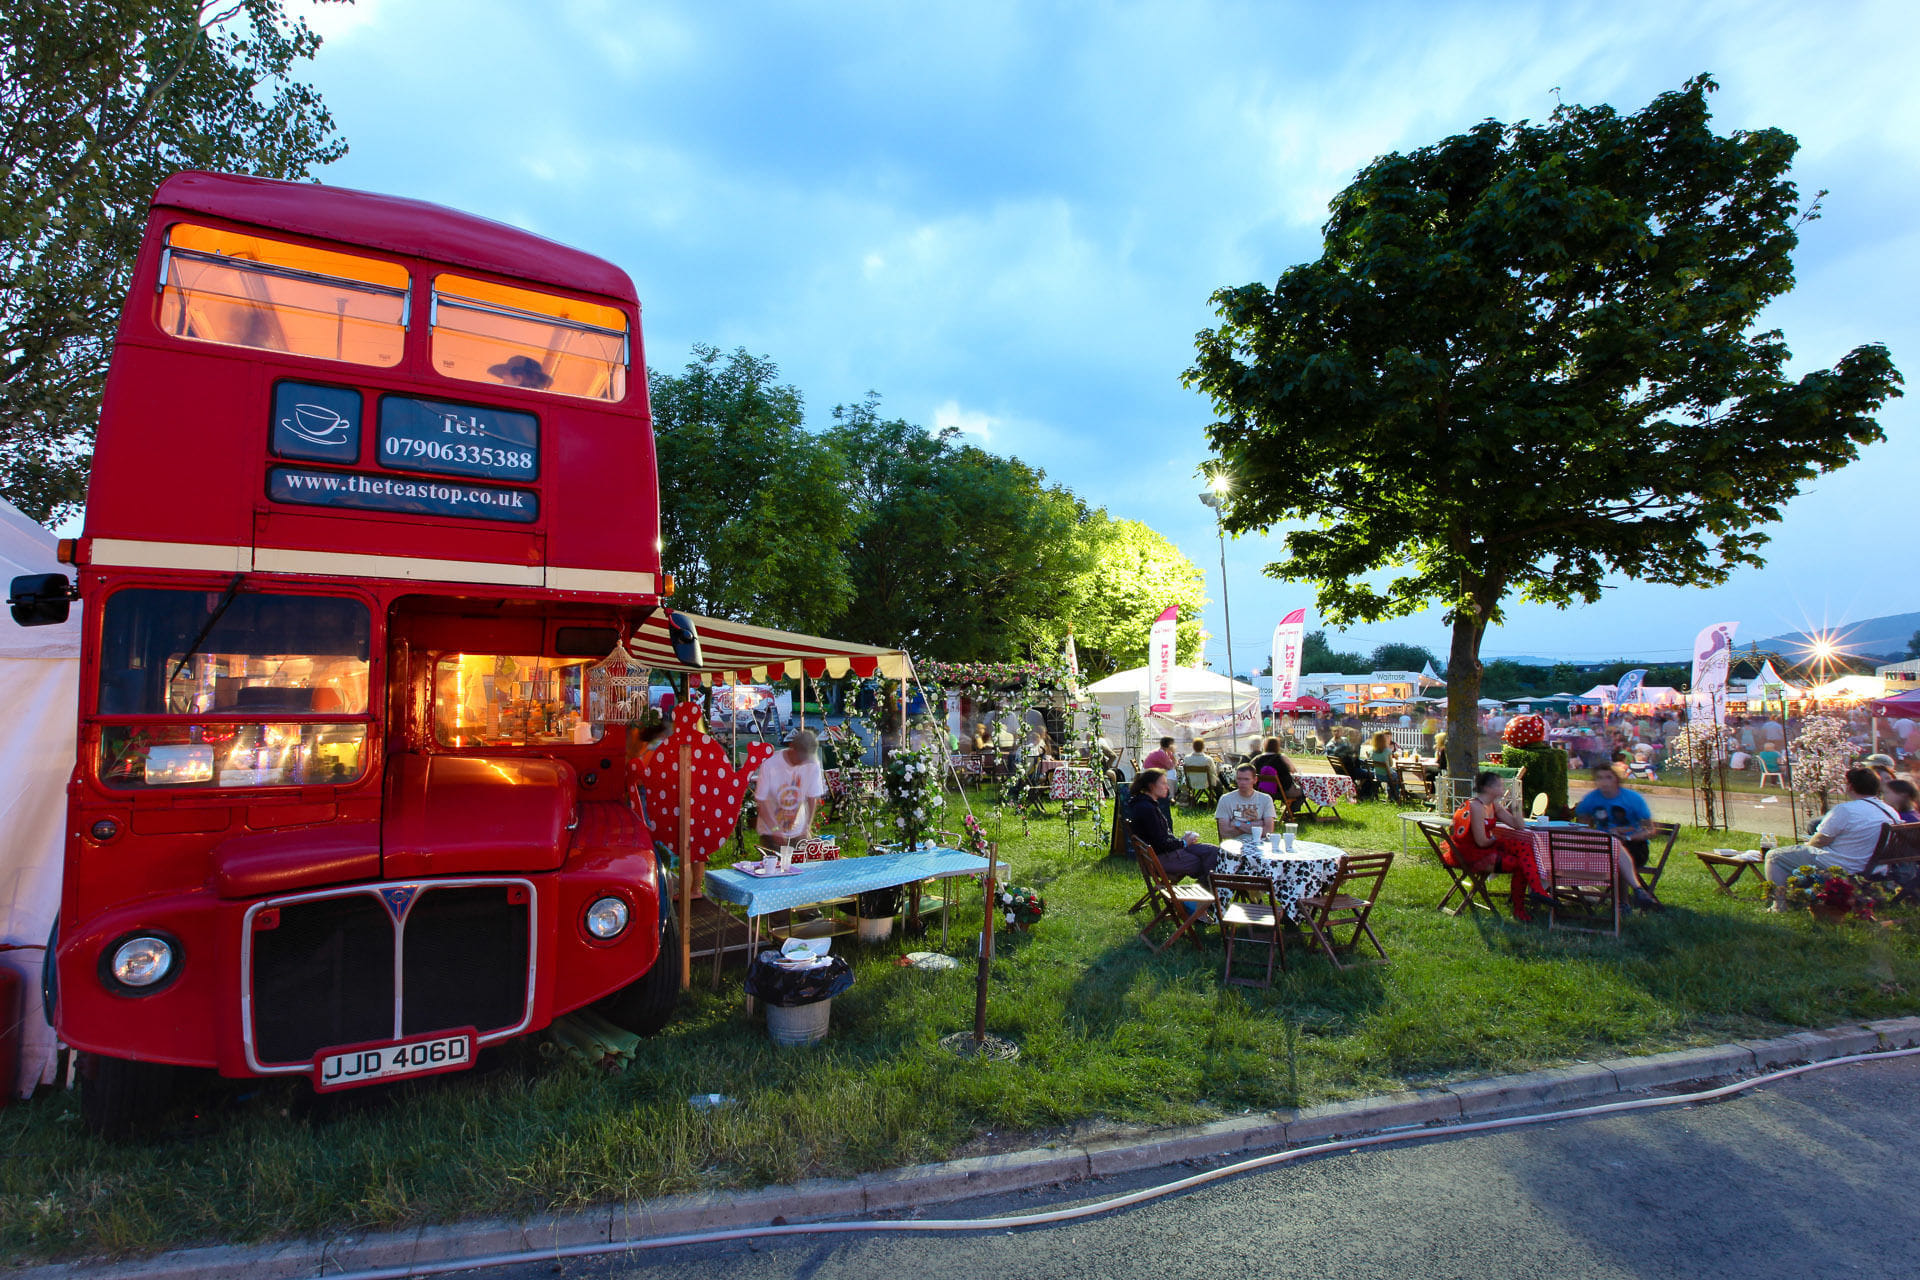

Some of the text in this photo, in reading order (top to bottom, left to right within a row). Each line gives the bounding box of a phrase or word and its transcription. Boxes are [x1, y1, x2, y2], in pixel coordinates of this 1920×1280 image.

[441, 413, 486, 437] Tel:
[385, 436, 533, 469] 07906335388
[286, 474, 524, 507] www.theteastop.co.uk
[324, 1038, 465, 1080] JJD 406D
